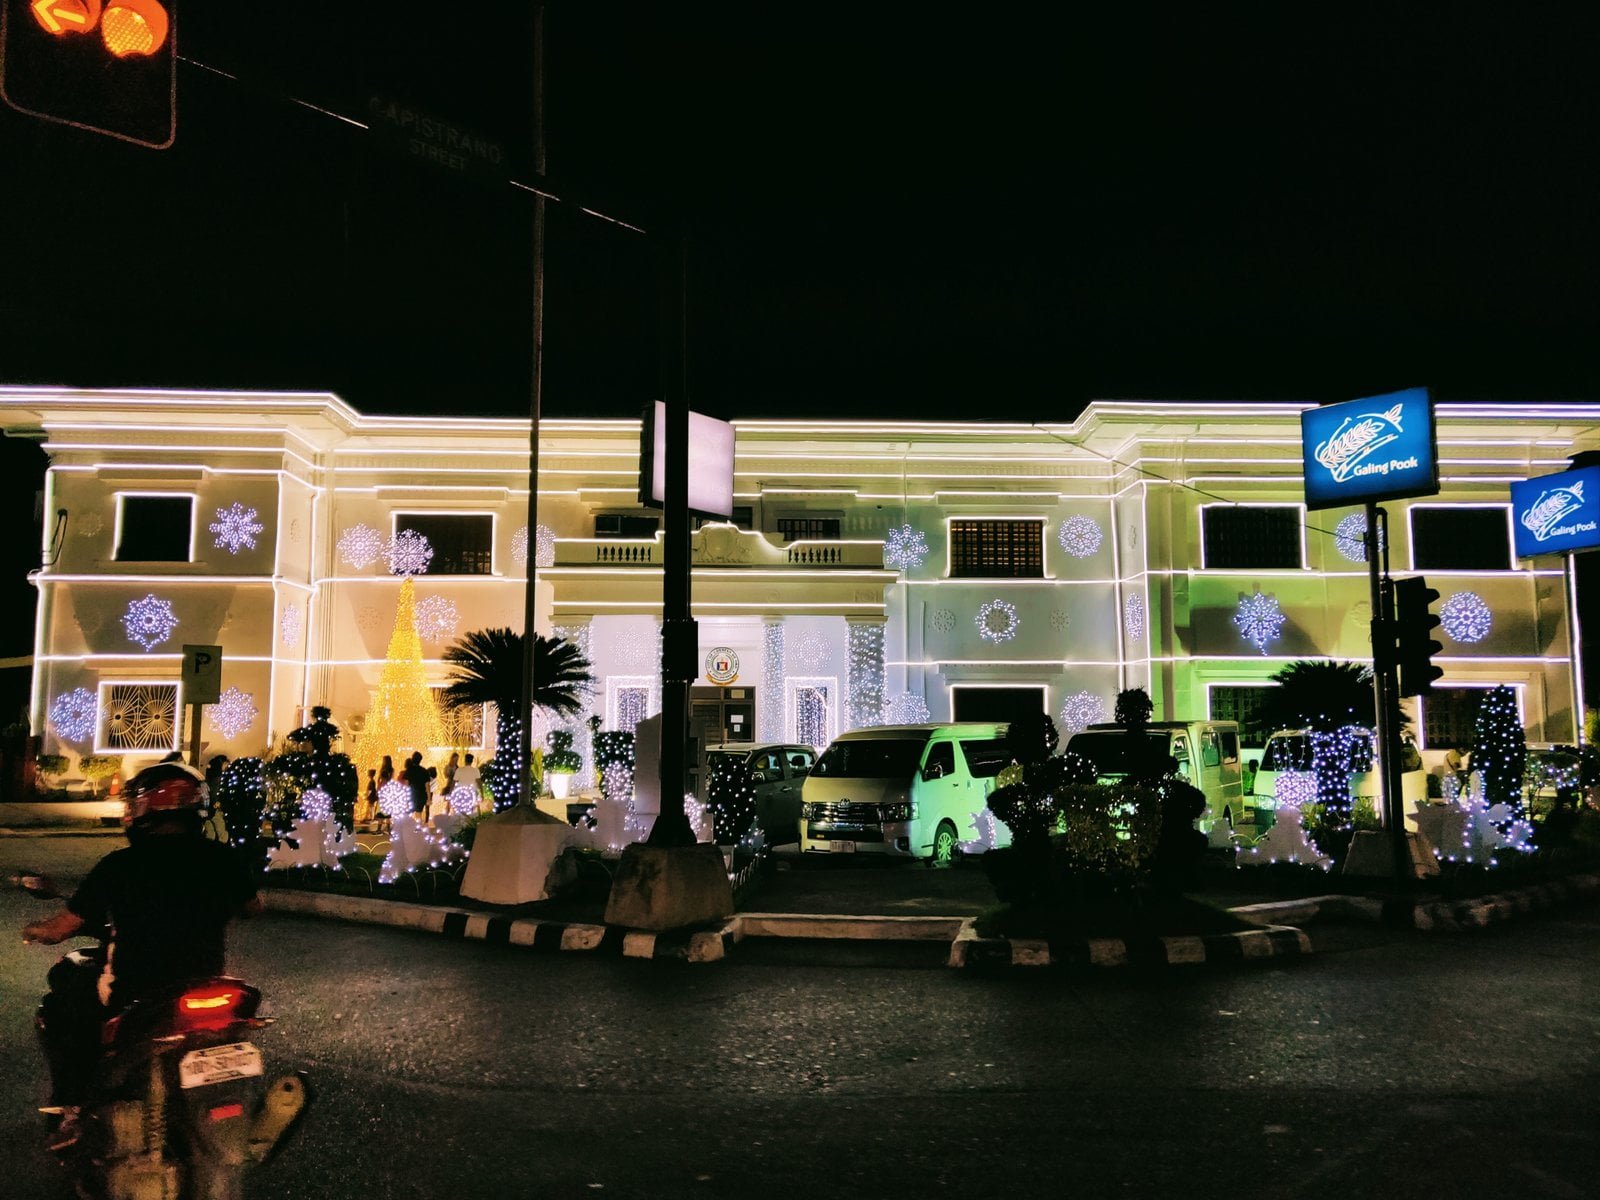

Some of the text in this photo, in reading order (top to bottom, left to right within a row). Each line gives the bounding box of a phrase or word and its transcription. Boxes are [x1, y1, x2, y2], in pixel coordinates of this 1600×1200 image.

[369, 96, 502, 164] CAPISTRANO
[410, 138, 466, 171] STREET
[1353, 456, 1418, 476] Galing Pook
[1551, 521, 1597, 536] Galing Pook
[195, 652, 211, 673] P
